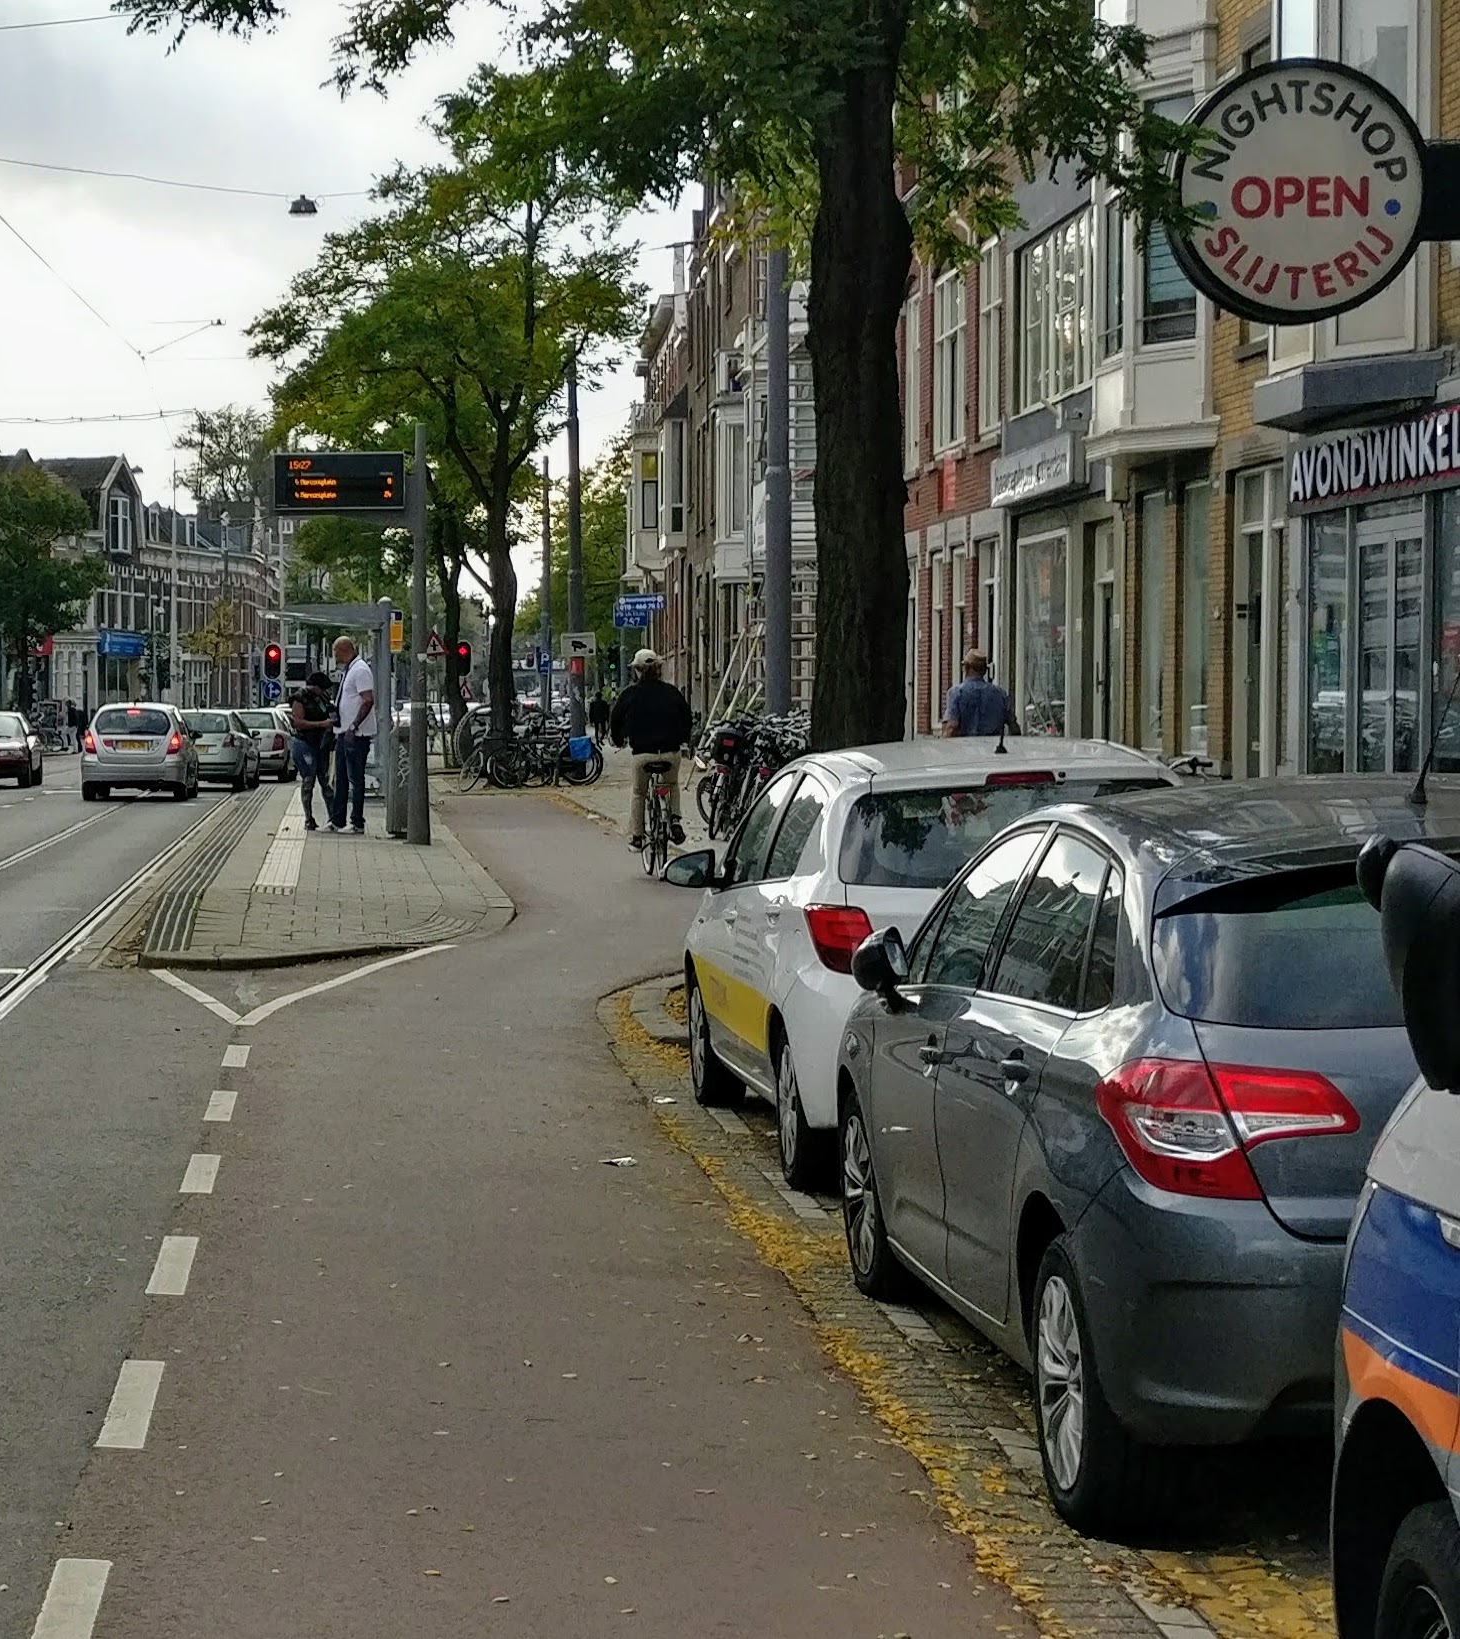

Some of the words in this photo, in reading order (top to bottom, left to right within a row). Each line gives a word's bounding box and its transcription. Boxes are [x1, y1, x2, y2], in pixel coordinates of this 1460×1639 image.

[1191, 80, 1407, 182] NIGHTSHOP
[1231, 175, 1370, 219] OPEN
[1204, 225, 1394, 300] SLIJTERIJ
[288, 461, 311, 470] 15:27
[1290, 409, 1460, 503] AVONDWINKEL
[541, 652, 549, 665] P
